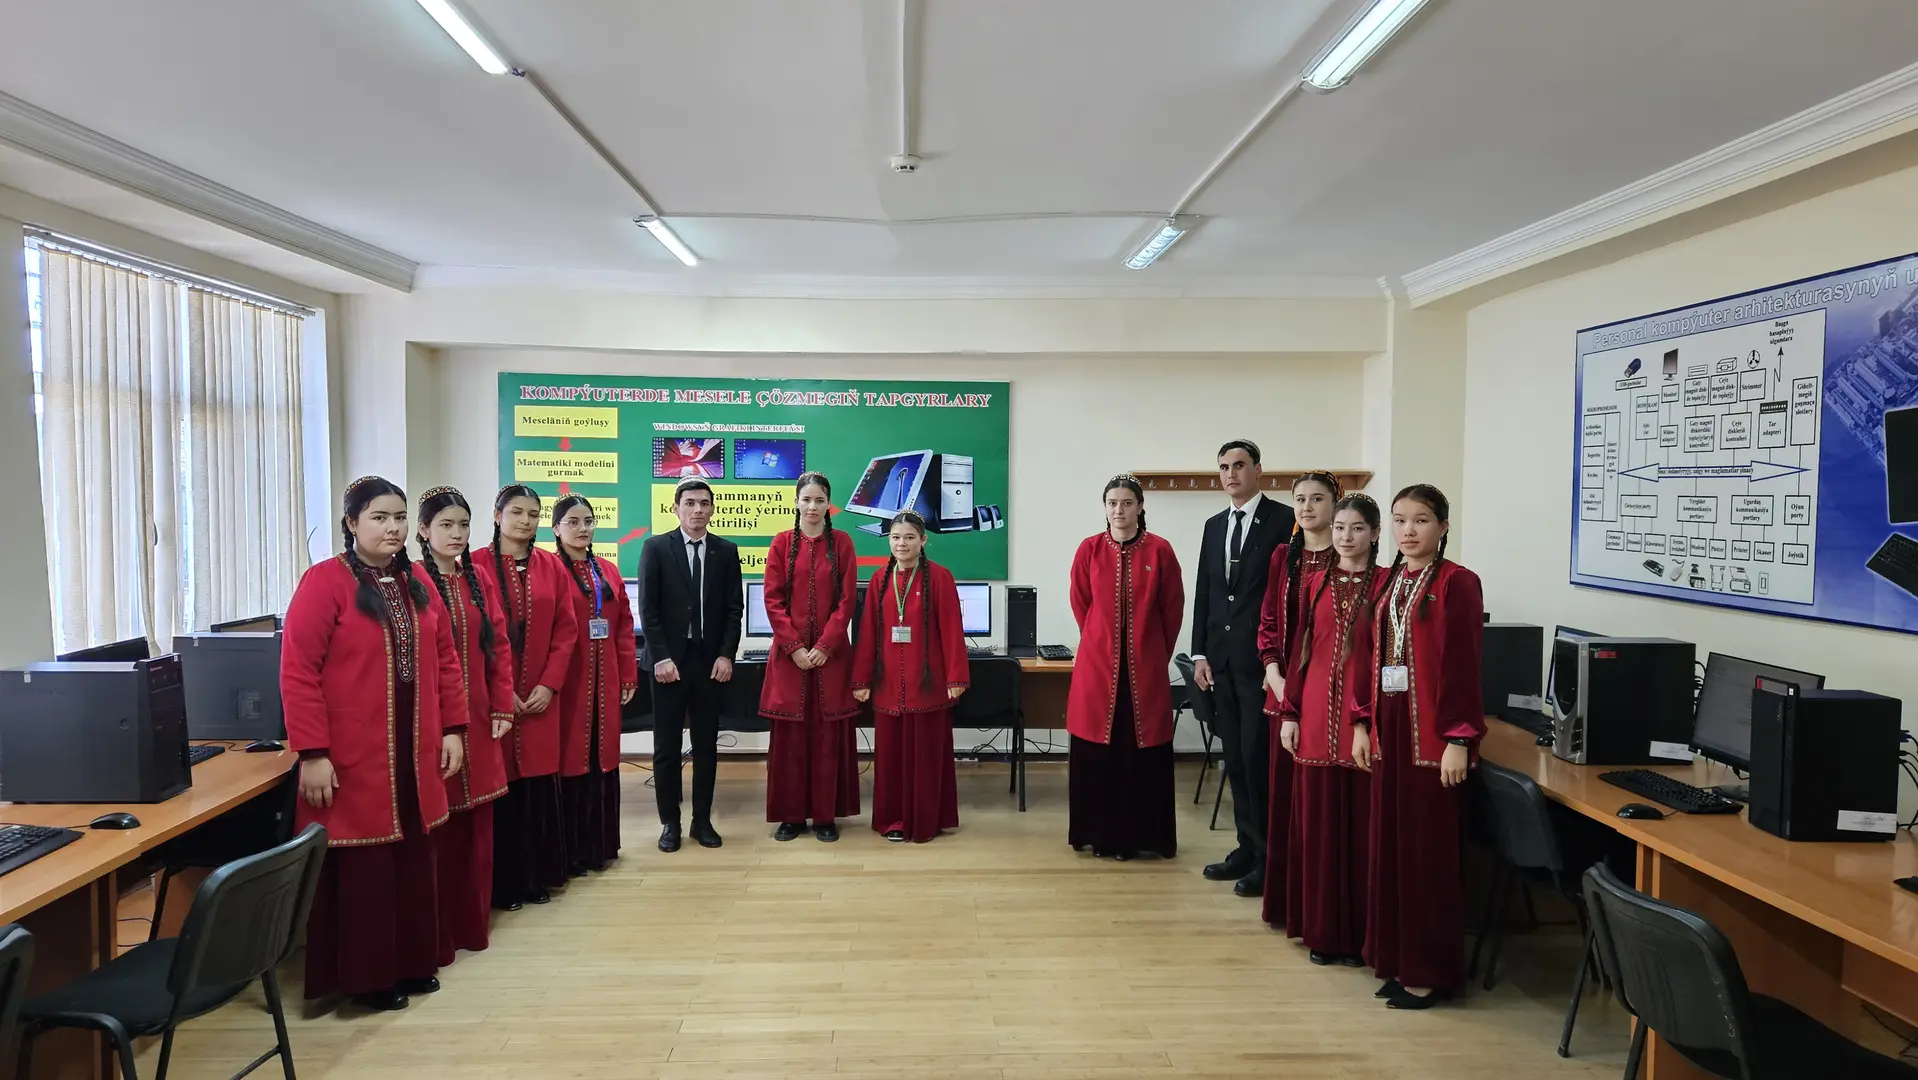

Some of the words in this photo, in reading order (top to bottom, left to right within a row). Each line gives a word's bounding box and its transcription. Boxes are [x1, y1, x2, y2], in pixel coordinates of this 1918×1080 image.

[1593, 322, 1647, 348] Personal
[1651, 308, 1731, 337] kompýuter
[1734, 267, 1898, 321] arhitekturasynyň
[520, 384, 670, 403] KOMPÝUTERDE
[674, 389, 751, 404] MESELE
[755, 389, 860, 407] ÇÖZMEGIŇ
[864, 392, 992, 408] TAPGYRLARY
[522, 416, 571, 425] Meseläniň
[573, 418, 610, 428] goýluşy
[517, 458, 572, 467] Matematiki
[574, 460, 615, 468] modelini
[547, 469, 584, 477] gurmak
[715, 491, 783, 504] ammanyň
[709, 518, 758, 530] etirilişi
